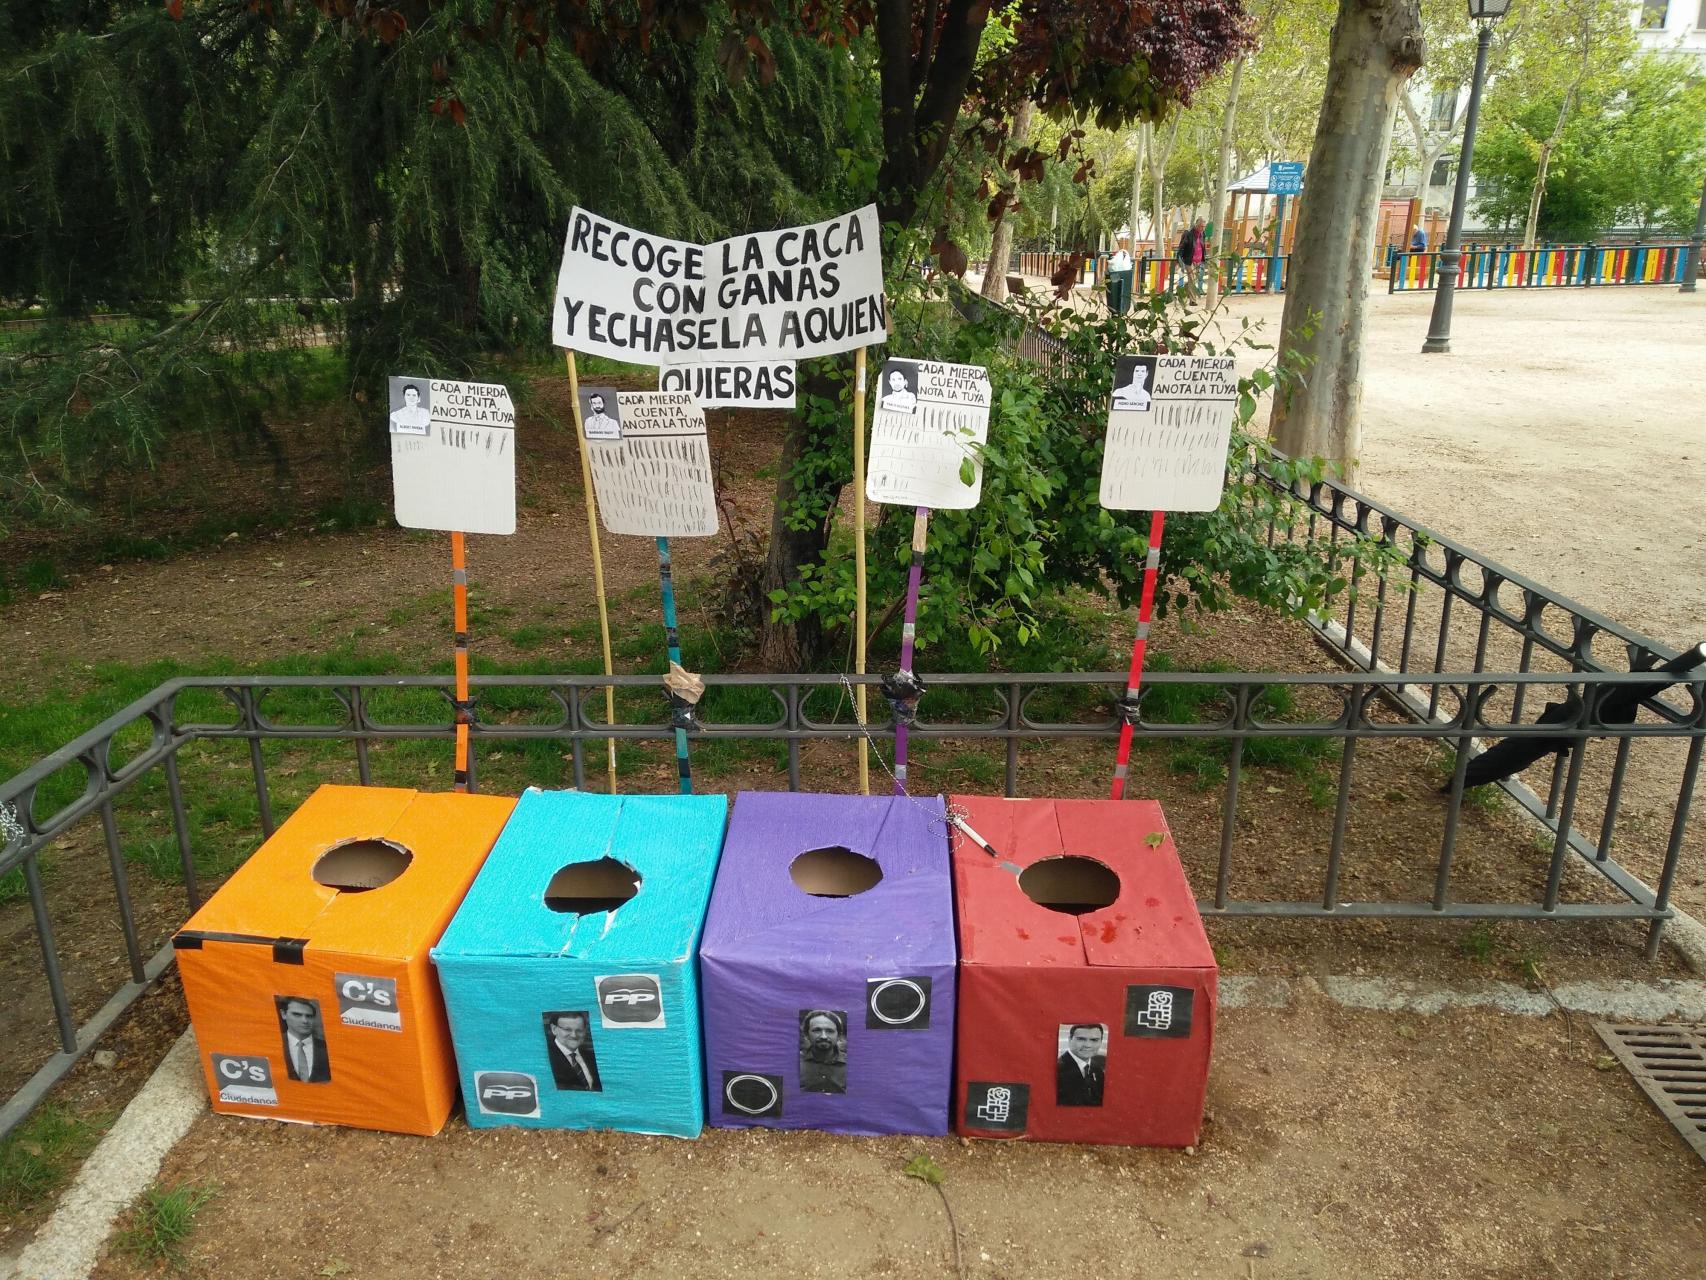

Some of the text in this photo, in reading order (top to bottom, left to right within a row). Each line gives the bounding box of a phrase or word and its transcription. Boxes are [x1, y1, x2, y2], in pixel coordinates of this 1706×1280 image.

[571, 213, 864, 280] RECOGE LA CACA
[632, 262, 841, 314] CON GANAS
[1158, 358, 1235, 370] CADA MIERDA
[918, 363, 988, 382] CADA MIERDA
[431, 382, 507, 399] CADA MIERDA
[661, 365, 794, 402] QUIERAS
[1153, 384, 1237, 395] ANOTA LA TUYA
[618, 394, 692, 405] CADA MIERDA
[947, 389, 958, 400] LA
[961, 392, 985, 404] TUYA
[432, 406, 514, 424] ANOTA LA TUYA
[622, 417, 706, 430] ANOTA LA TUYA
[341, 979, 391, 1007] C's
[604, 992, 656, 1006] PP
[341, 1015, 402, 1031] Ciudadanos
[219, 1058, 266, 1083] C's
[220, 1091, 278, 1105] Ciudadanos
[483, 1088, 532, 1100] PP
